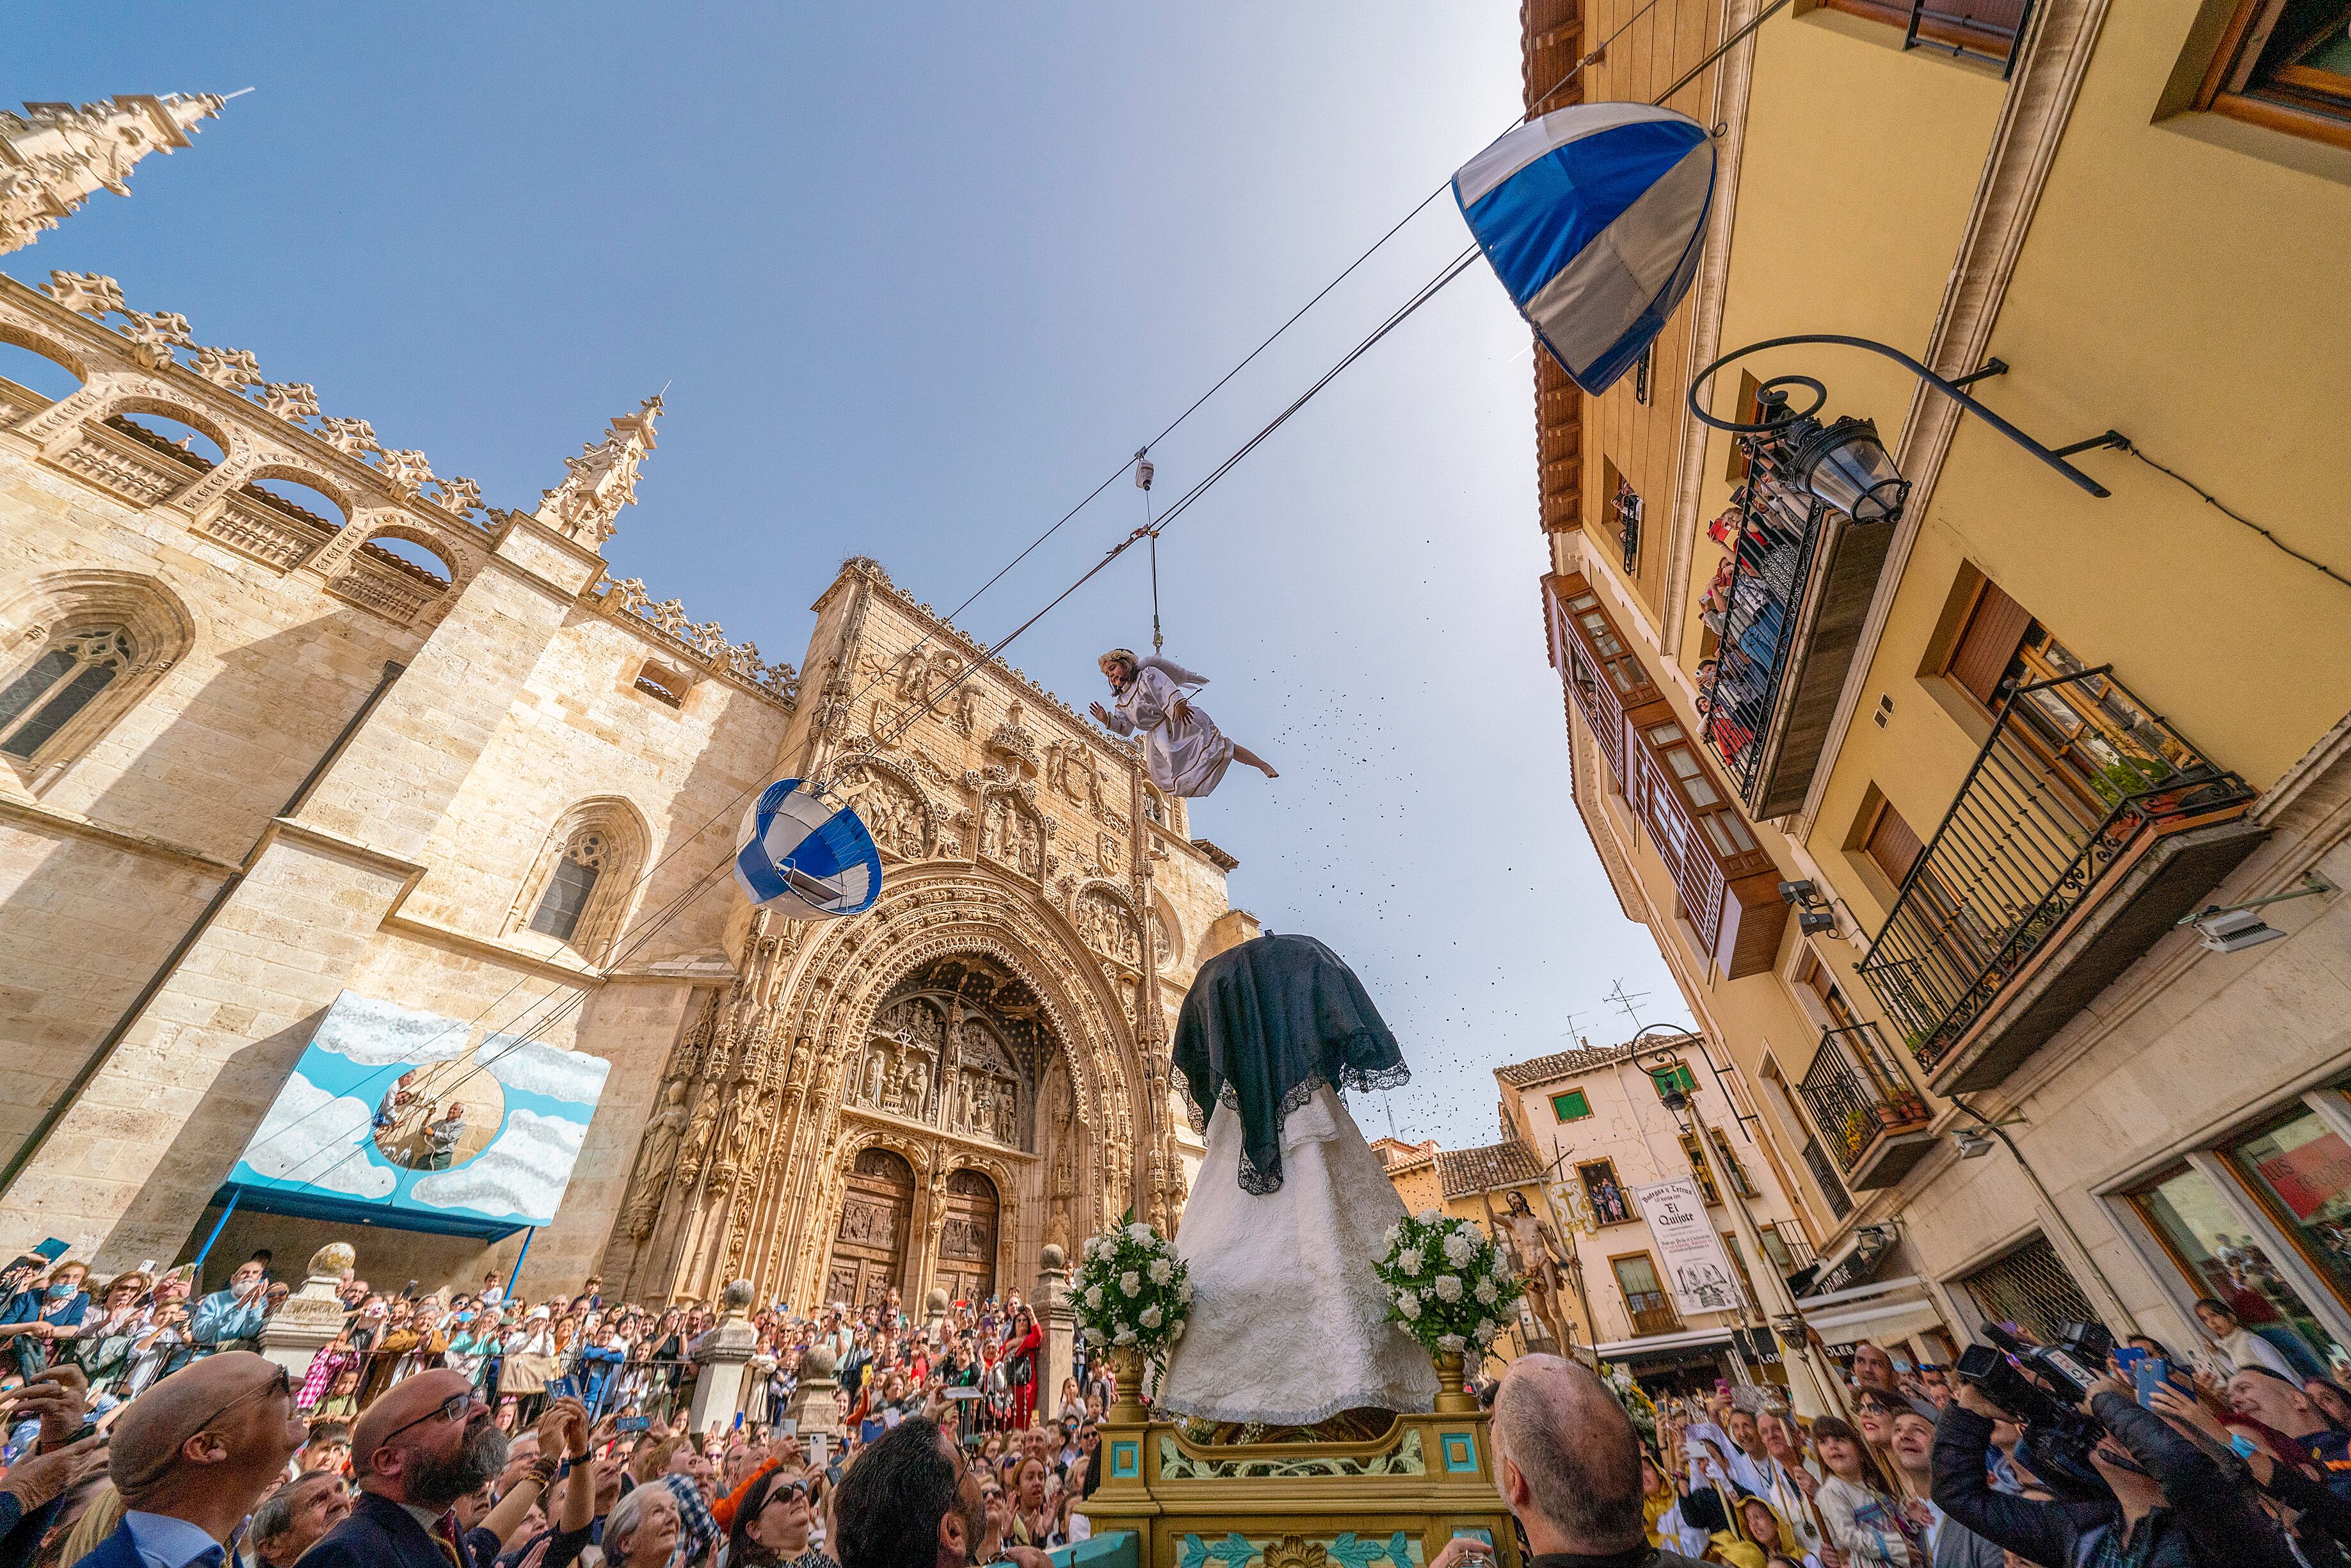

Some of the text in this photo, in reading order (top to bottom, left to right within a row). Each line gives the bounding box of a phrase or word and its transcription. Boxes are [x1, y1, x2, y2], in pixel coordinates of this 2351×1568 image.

[1665, 1203, 1679, 1213] El
[1658, 1213, 1694, 1225] Quijote
[1760, 1352, 1782, 1364] LOS
